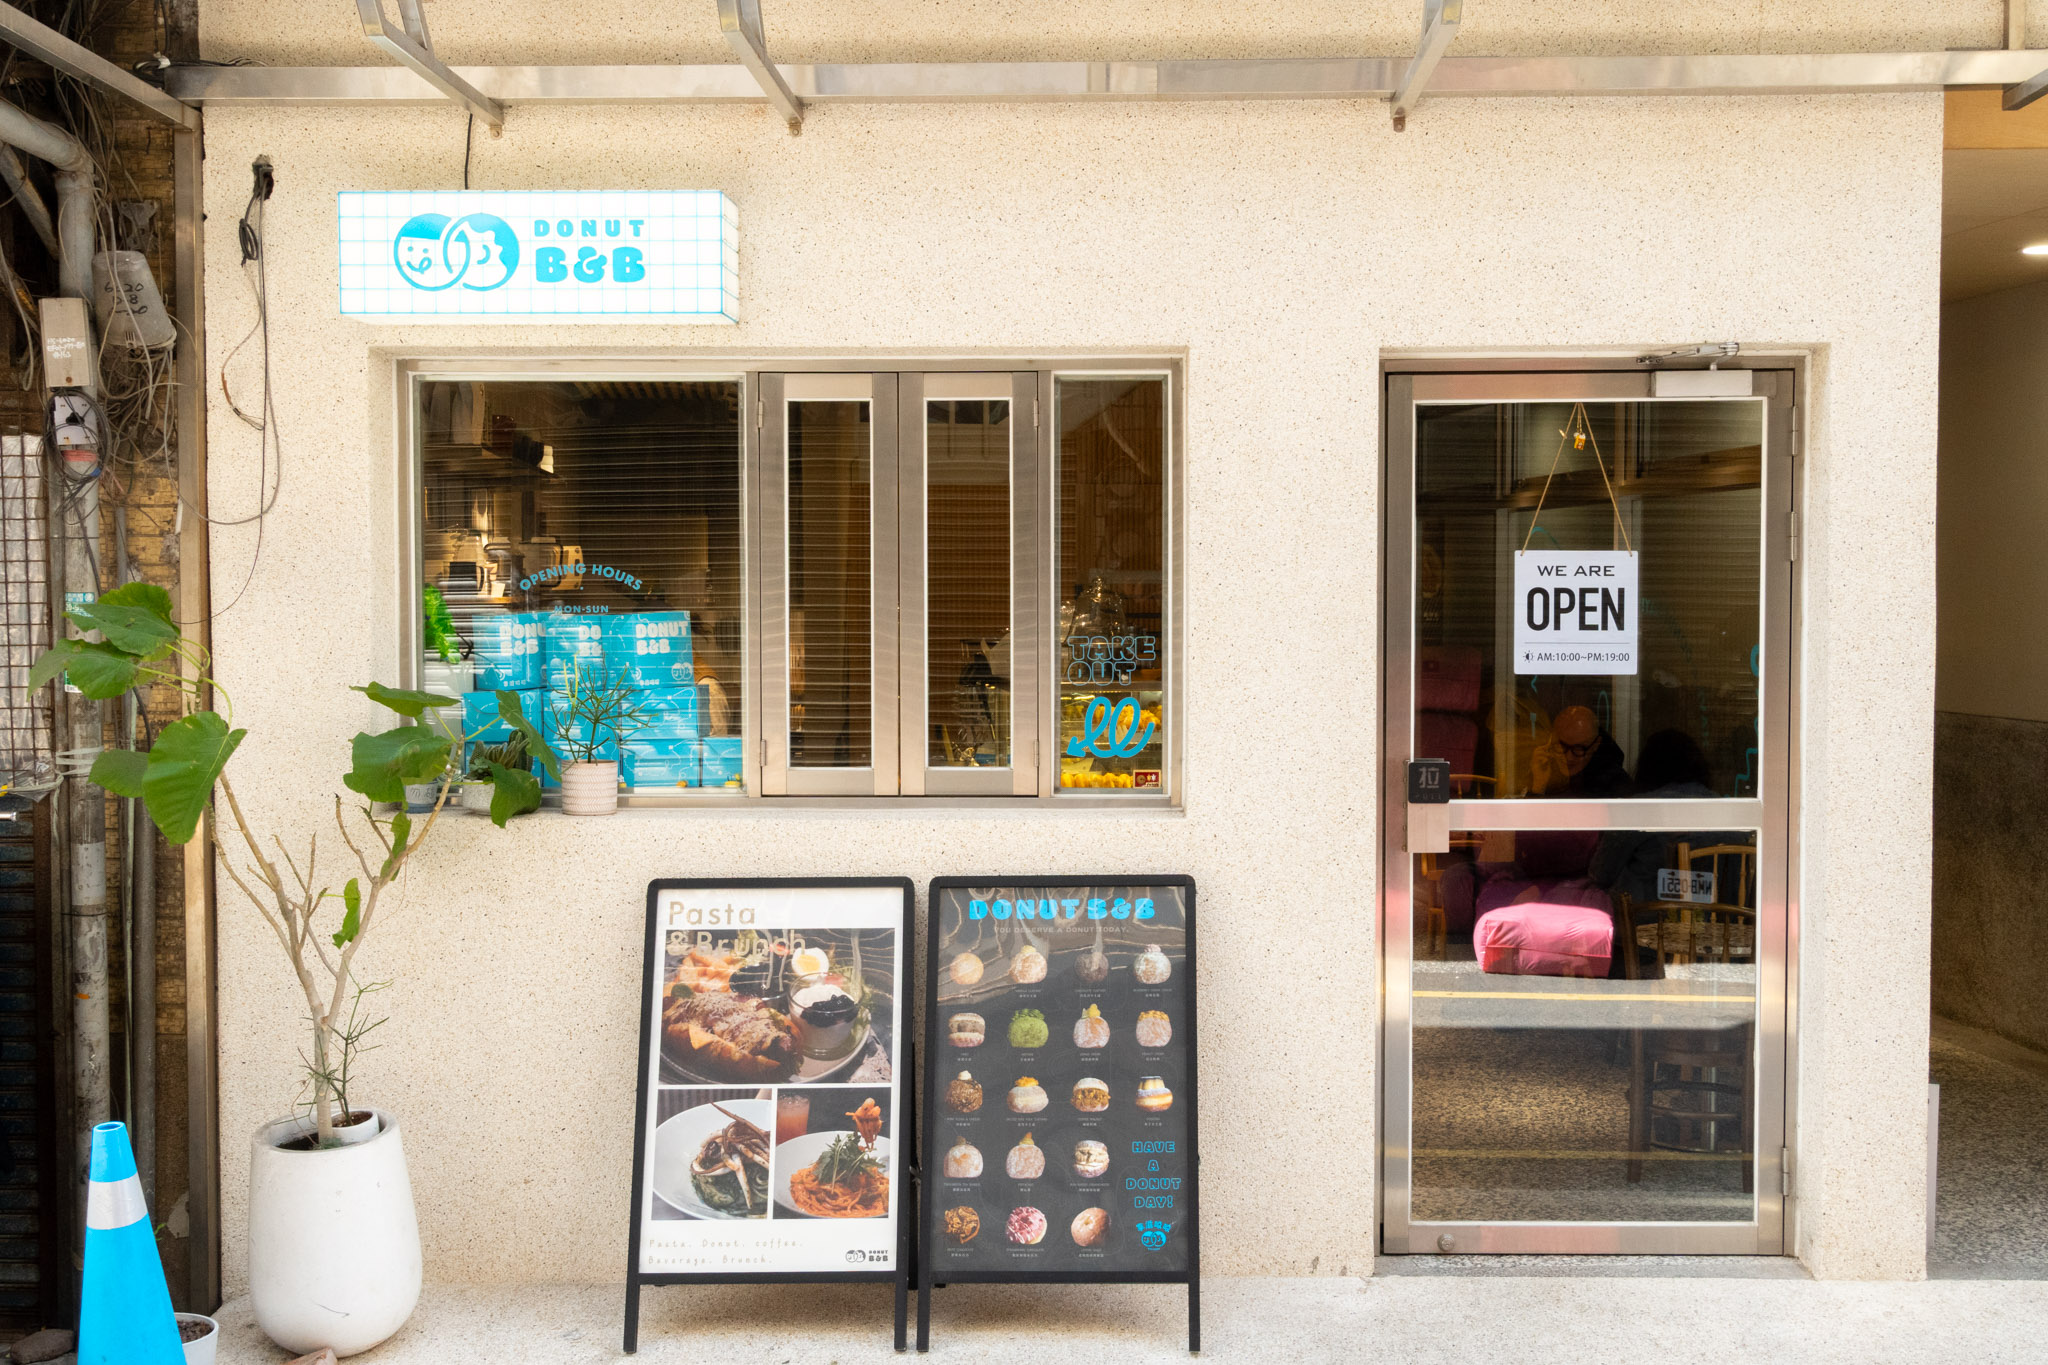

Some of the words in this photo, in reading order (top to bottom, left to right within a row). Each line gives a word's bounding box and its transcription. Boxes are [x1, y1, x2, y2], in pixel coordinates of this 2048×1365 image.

[534, 219, 645, 237] DONUT
[535, 246, 646, 283] B&B
[519, 563, 586, 590] OPENING
[592, 564, 643, 590] HOURS
[1537, 565, 1567, 577] WE
[1574, 565, 1615, 577] ARE
[554, 605, 609, 613] MON-SUN
[1527, 587, 1625, 631] OPEN
[636, 621, 688, 639] DONUT
[637, 638, 671, 656] B&B
[1067, 636, 1156, 661] TAKE
[1067, 661, 1136, 686] OUT
[1419, 766, 1440, 789] 拉
[668, 901, 755, 925] Pasta
[969, 898, 1080, 920] DONUT
[1087, 897, 1155, 919] B&B
[666, 930, 690, 956] &
[696, 929, 806, 956] Brunch
[1132, 1141, 1175, 1153] HAVE
[1147, 1159, 1159, 1171] A
[1126, 1177, 1181, 1190] DONUT
[1134, 1195, 1173, 1208] DAY!
